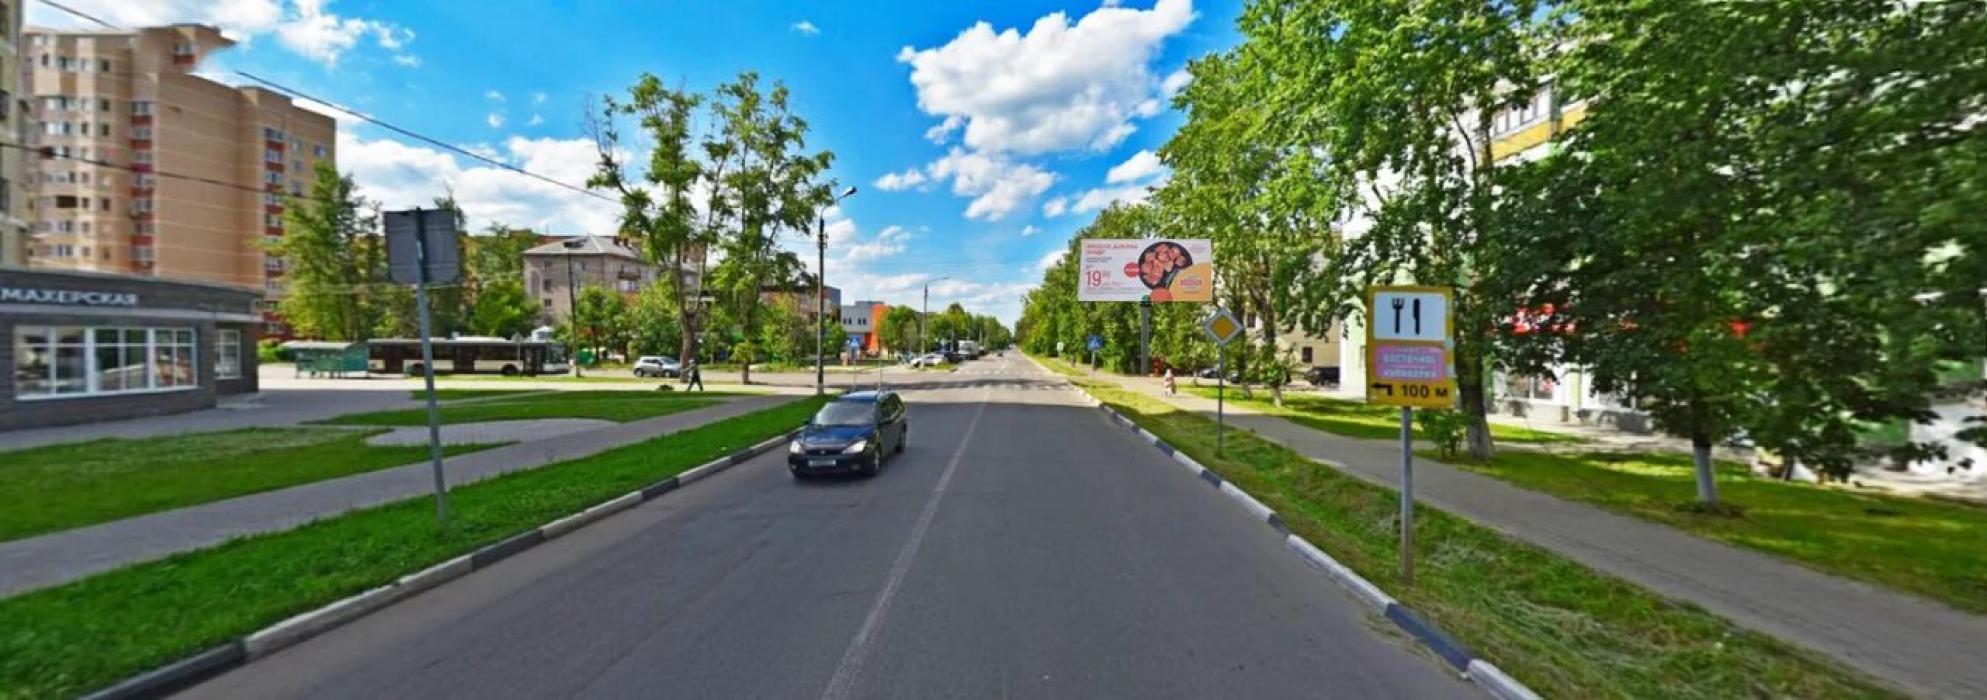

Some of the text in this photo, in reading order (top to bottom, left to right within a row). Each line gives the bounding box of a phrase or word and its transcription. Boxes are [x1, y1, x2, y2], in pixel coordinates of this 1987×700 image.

[0, 288, 137, 305] МАХЕРСКАЯ
[1382, 353, 1437, 365] ВОСТОЧНО
[1402, 384, 1430, 398] 100
